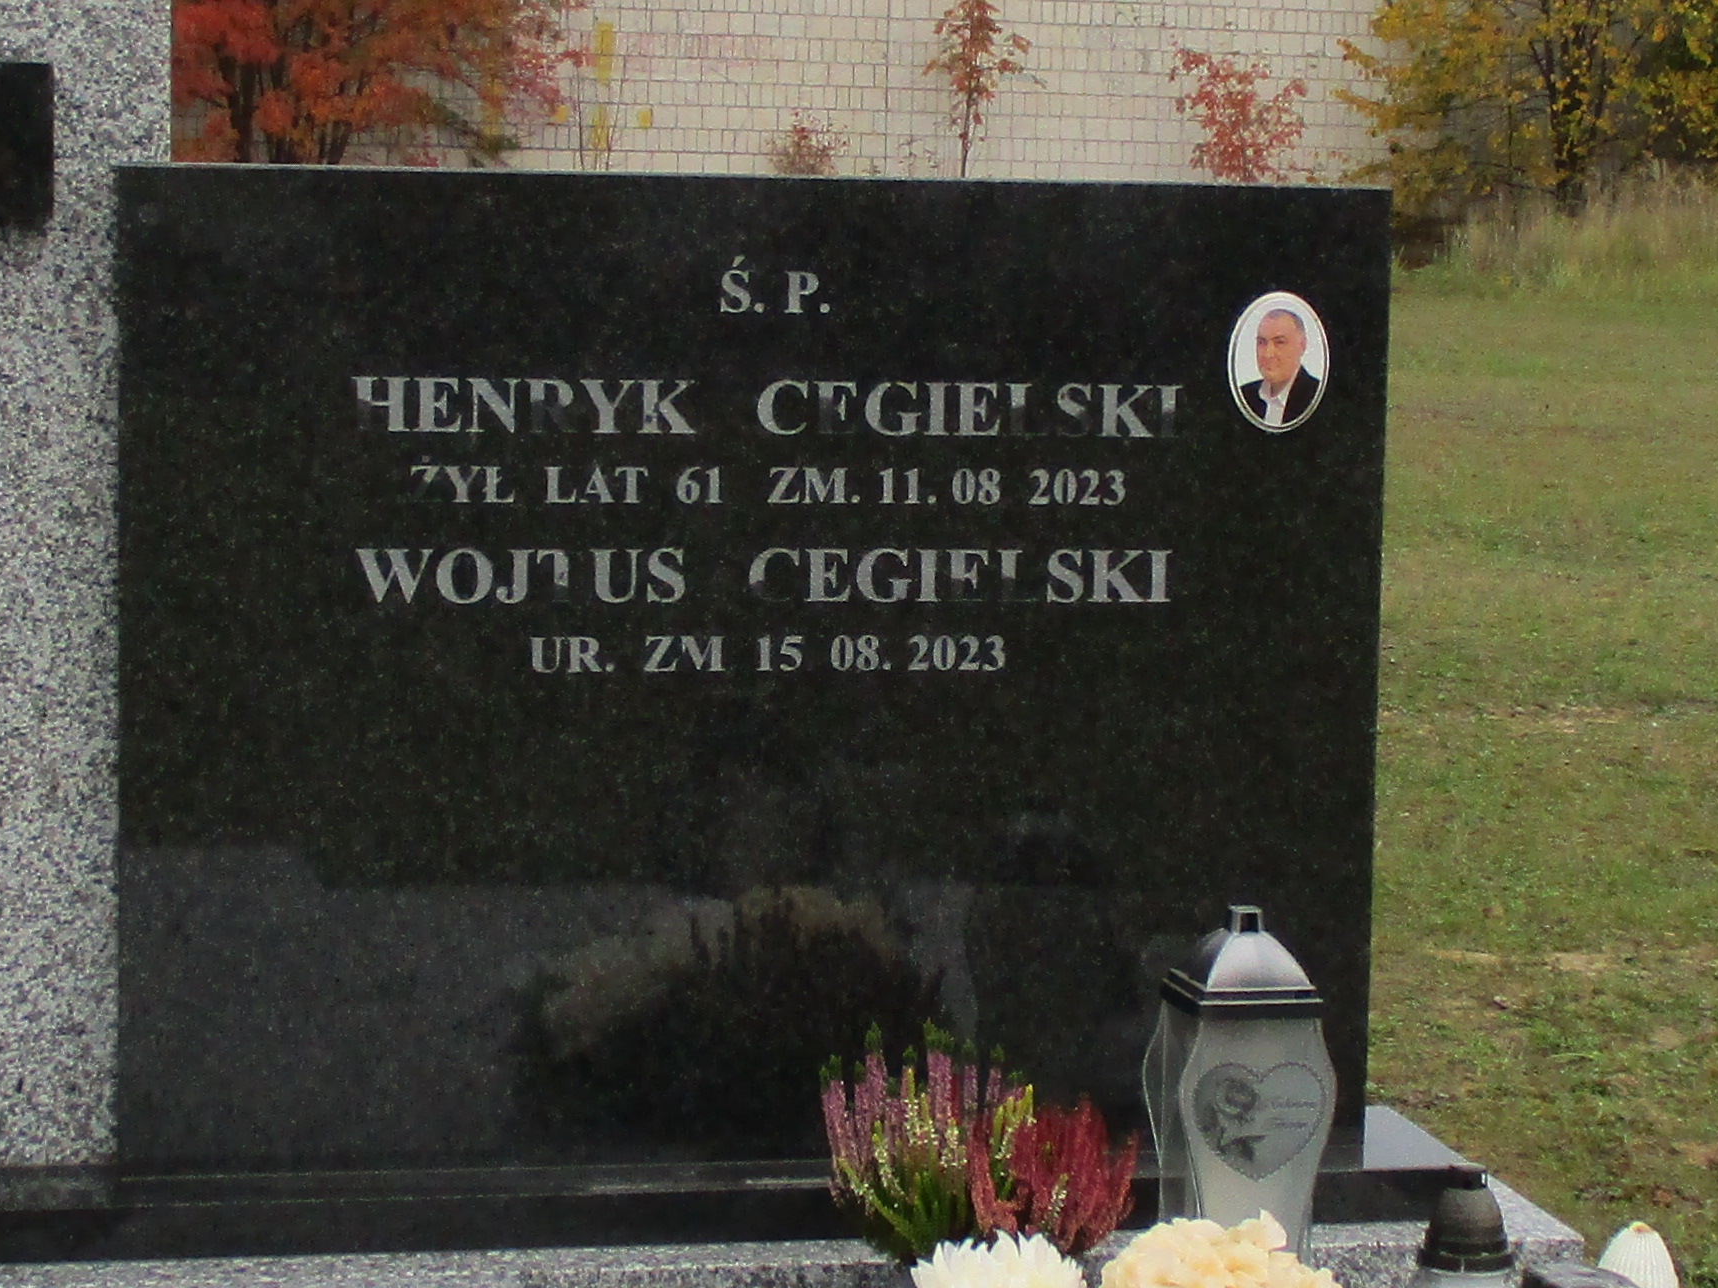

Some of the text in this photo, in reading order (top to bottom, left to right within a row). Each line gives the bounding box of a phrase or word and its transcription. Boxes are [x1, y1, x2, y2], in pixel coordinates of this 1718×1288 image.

[720, 254, 831, 314] Ś. P.
[351, 376, 1183, 438] HENRYK CEGIELSKI
[544, 465, 649, 504] LAT
[676, 466, 723, 504] 61
[767, 467, 861, 505] ZM.
[1028, 469, 1128, 507] 2023
[748, 547, 1174, 604] CEGIELSKI
[530, 635, 617, 674] UR.
[644, 635, 726, 673] ZM
[756, 635, 805, 672] 15
[908, 635, 1006, 672] 2023
